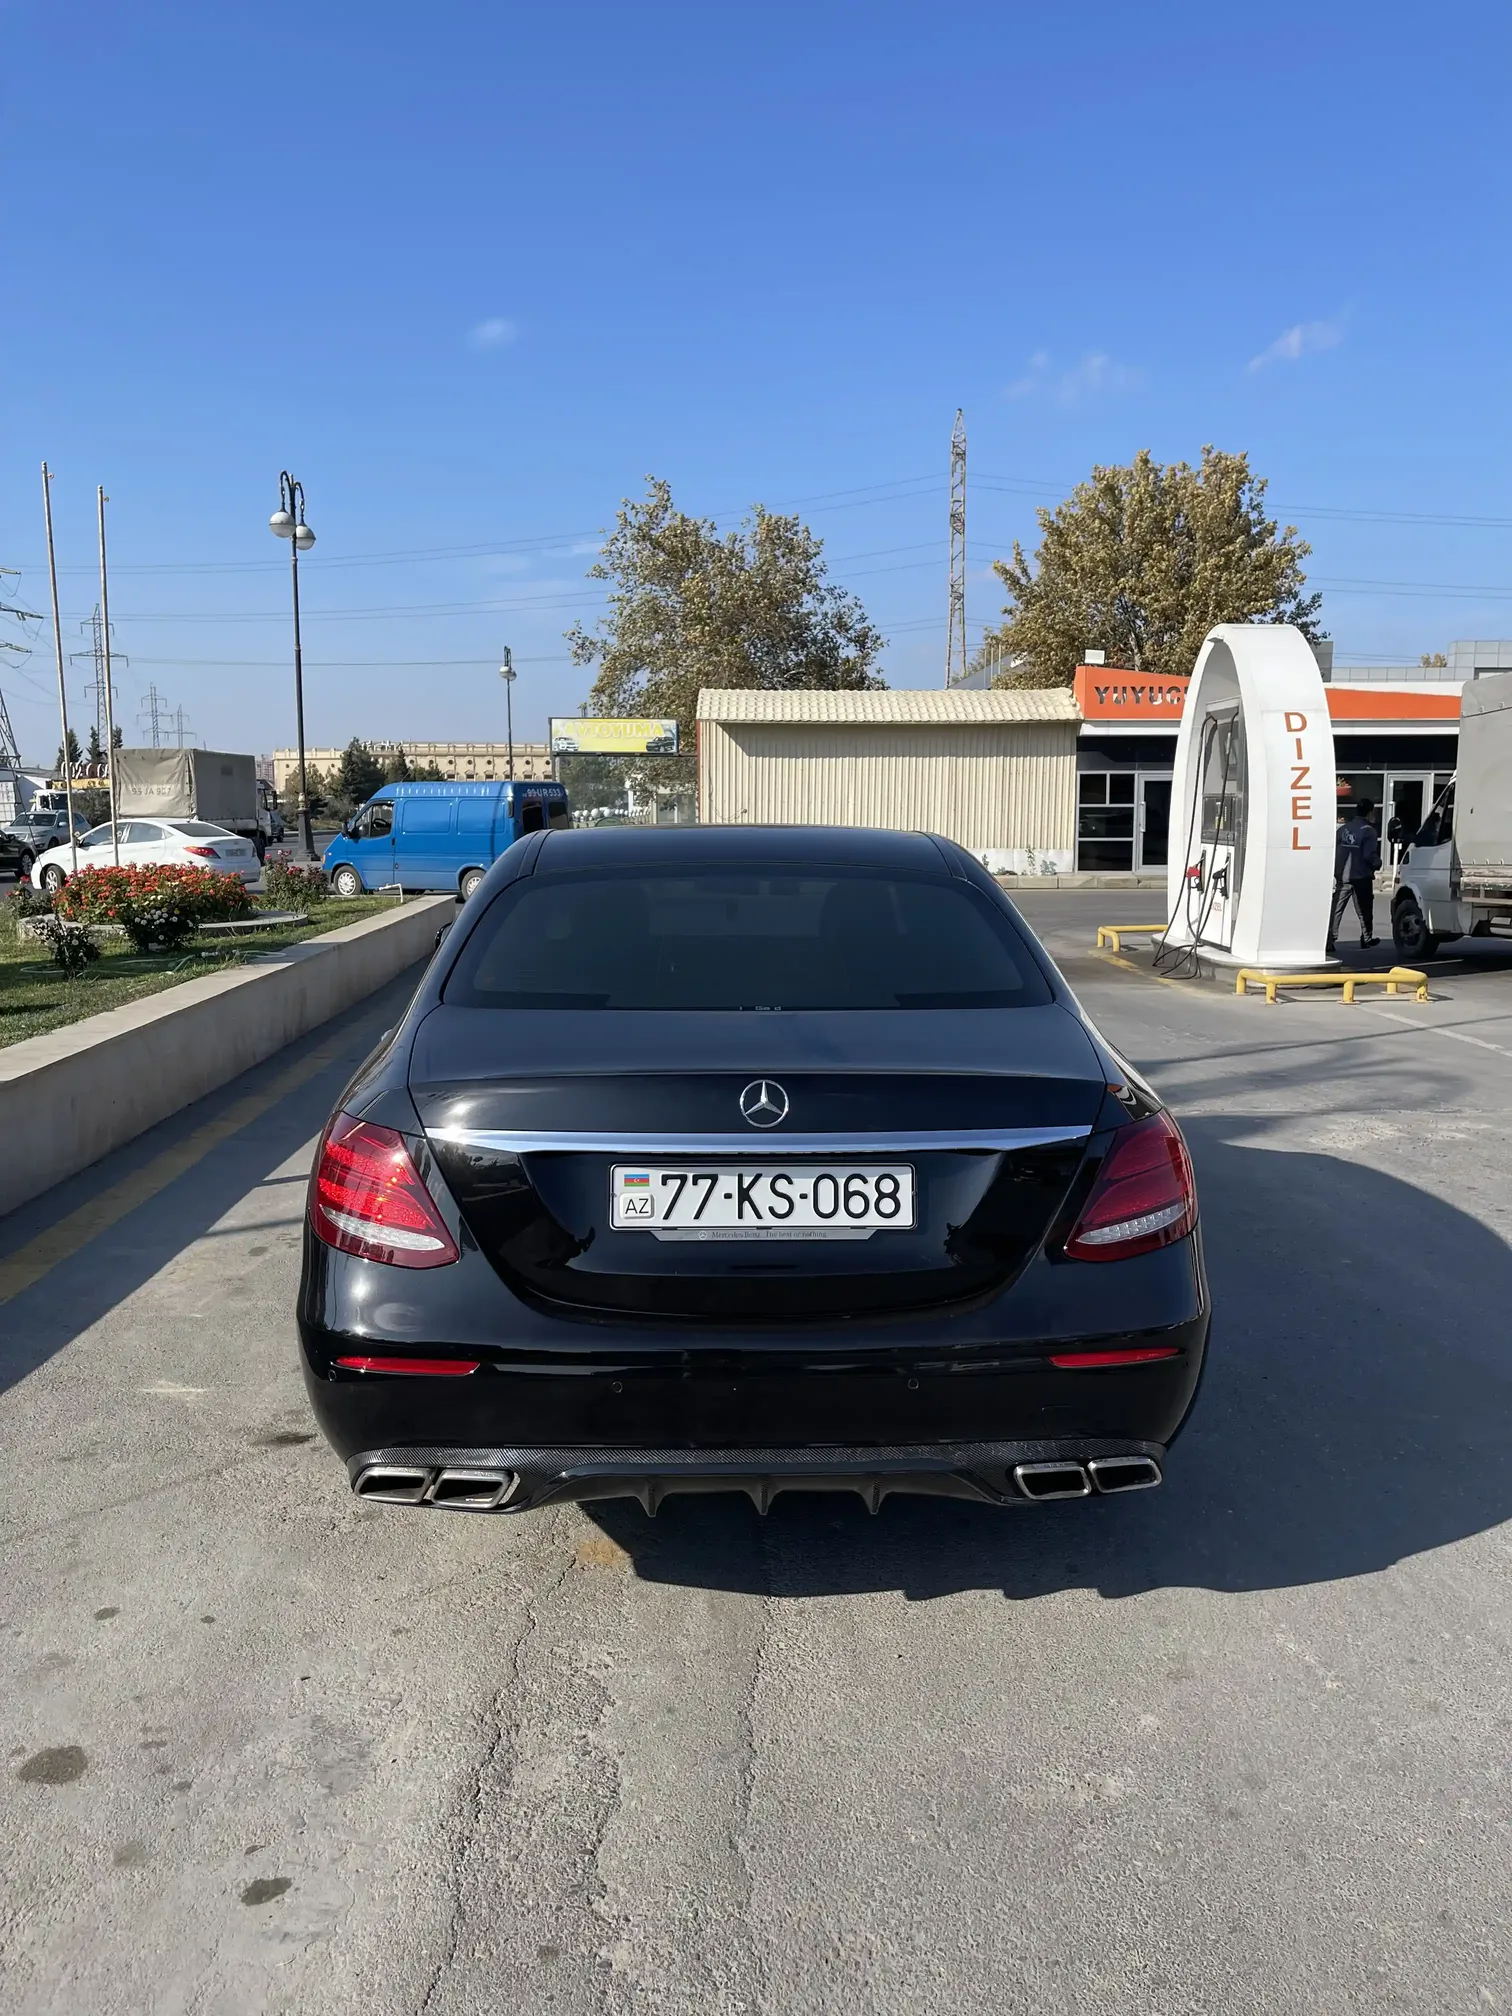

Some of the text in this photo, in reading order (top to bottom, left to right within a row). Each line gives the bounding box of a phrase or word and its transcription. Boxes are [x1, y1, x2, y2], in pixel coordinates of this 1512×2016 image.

[1284, 711, 1313, 851] DIZEL
[624, 1197, 650, 1215] AZ
[660, 1172, 902, 1221] 77-KS-068
